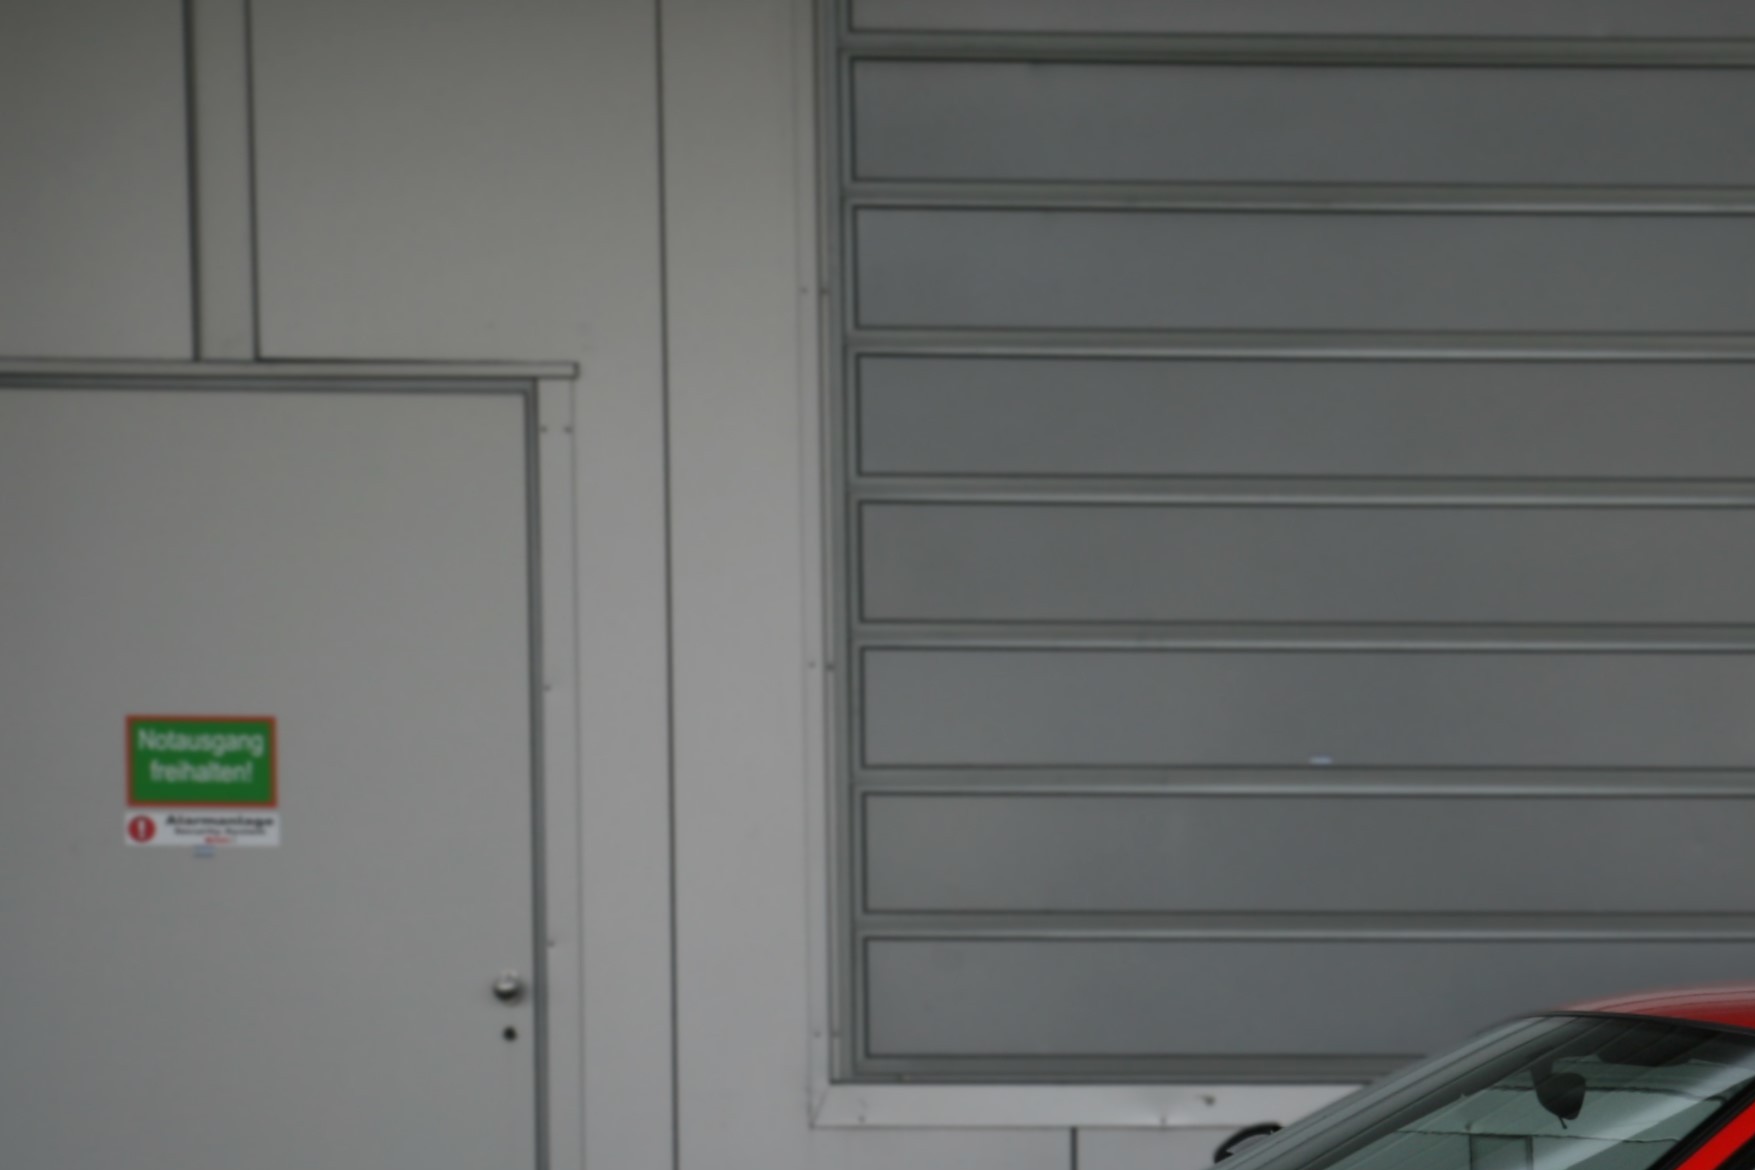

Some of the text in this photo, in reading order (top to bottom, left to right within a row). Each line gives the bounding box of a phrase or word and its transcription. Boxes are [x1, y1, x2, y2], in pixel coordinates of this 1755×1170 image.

[137, 727, 264, 758] Notausgang
[150, 758, 253, 782] freihalten!
[165, 813, 275, 829] Alarmanlage
